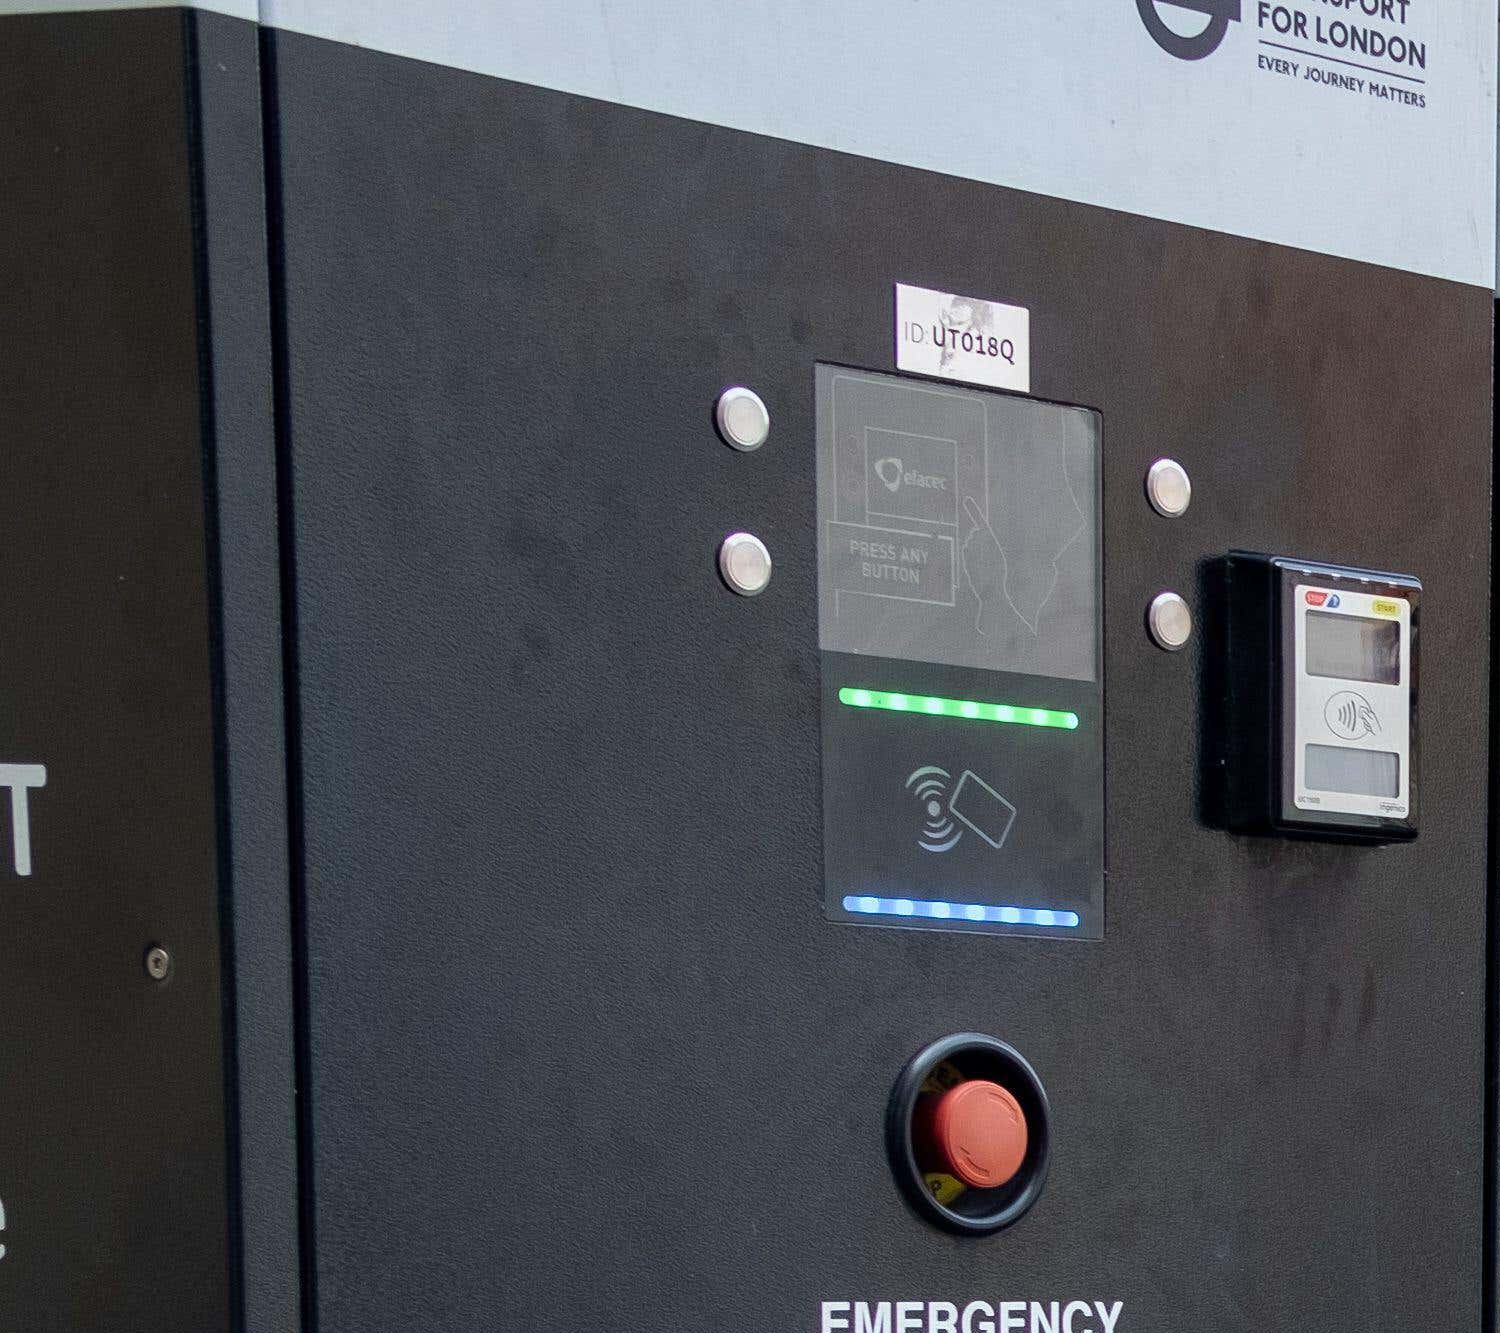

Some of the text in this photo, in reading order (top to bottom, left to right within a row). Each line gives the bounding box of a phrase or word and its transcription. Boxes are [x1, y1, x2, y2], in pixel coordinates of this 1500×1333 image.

[1258, 2, 1308, 40] FOR
[1316, 20, 1426, 69] LONDON
[1257, 55, 1426, 109] EVERY JOURNEY MATTERS
[932, 324, 1015, 365] UT018Q
[850, 539, 929, 565] PRESS ANY
[862, 563, 920, 586] BUTTON
